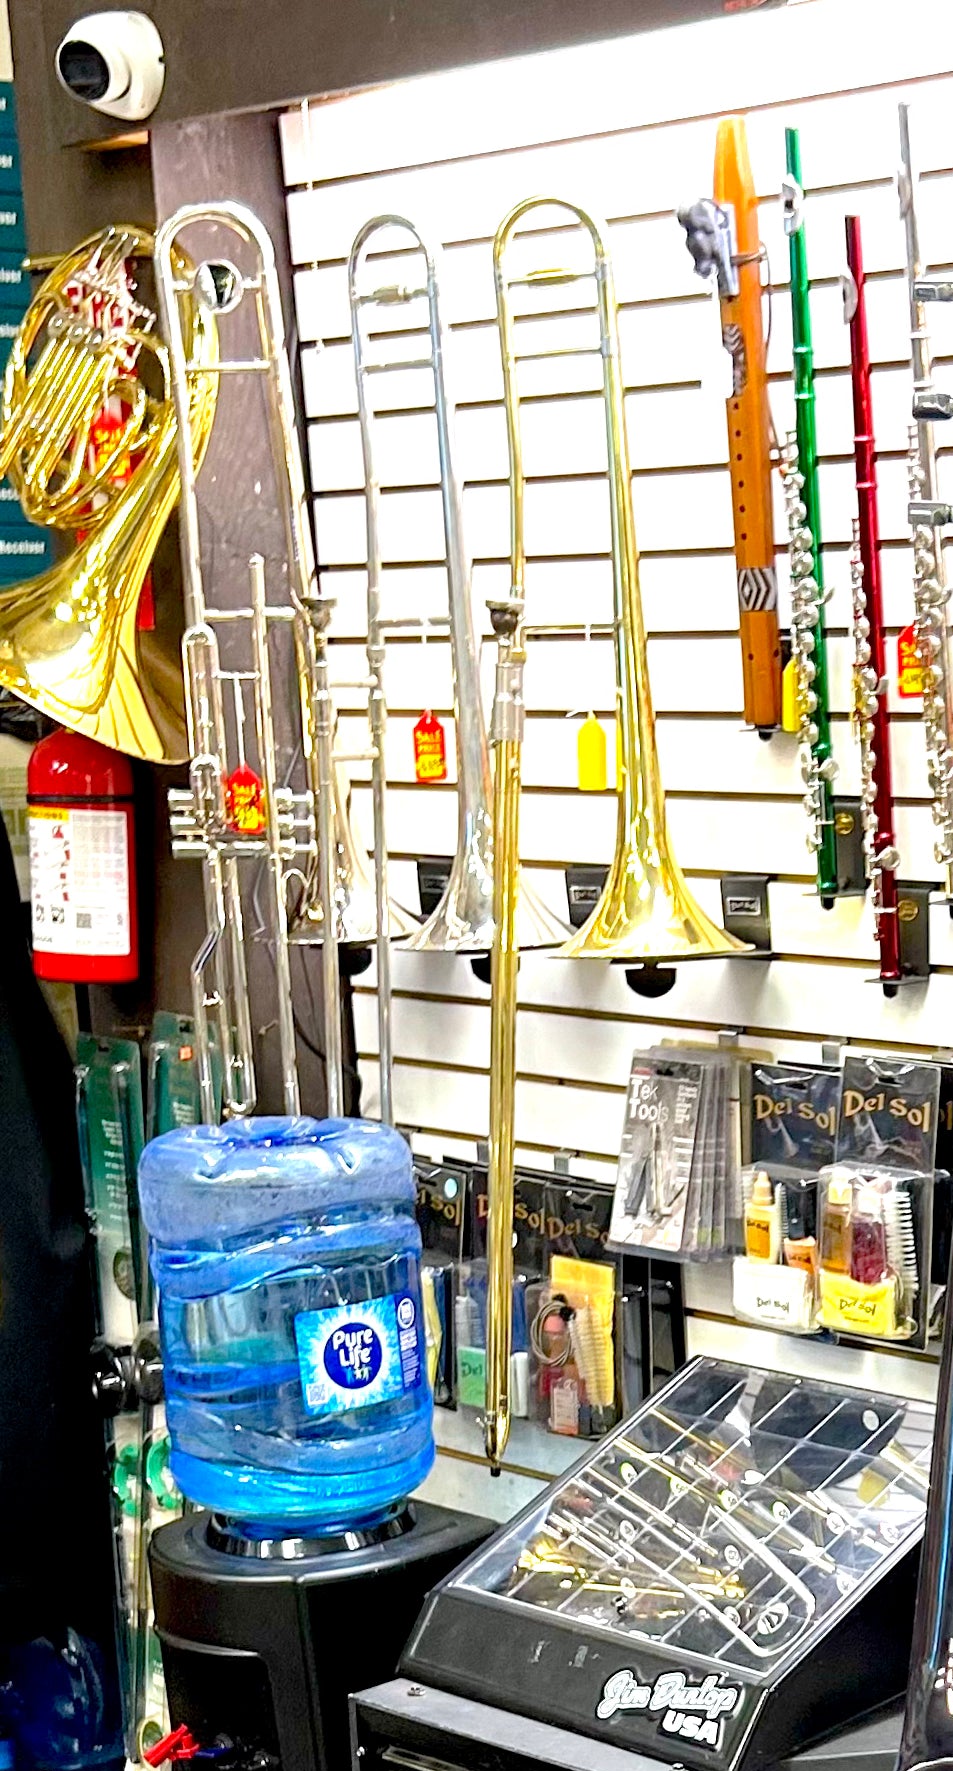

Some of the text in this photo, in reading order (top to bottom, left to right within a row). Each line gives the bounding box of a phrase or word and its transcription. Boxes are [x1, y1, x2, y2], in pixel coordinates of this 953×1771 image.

[416, 730, 440, 744] SALE
[631, 1079, 658, 1100] Tek
[629, 1098, 669, 1121] Tools
[754, 1094, 836, 1136] Del Sol
[843, 1090, 931, 1133] Del Sol
[431, 1197, 460, 1226] Sol
[515, 1202, 546, 1235] Sol
[547, 1216, 581, 1240] Del
[332, 1328, 374, 1350] Pure
[339, 1346, 372, 1369] Life
[597, 1669, 738, 1719] Jim Dunlop
[662, 1709, 719, 1745] USA
